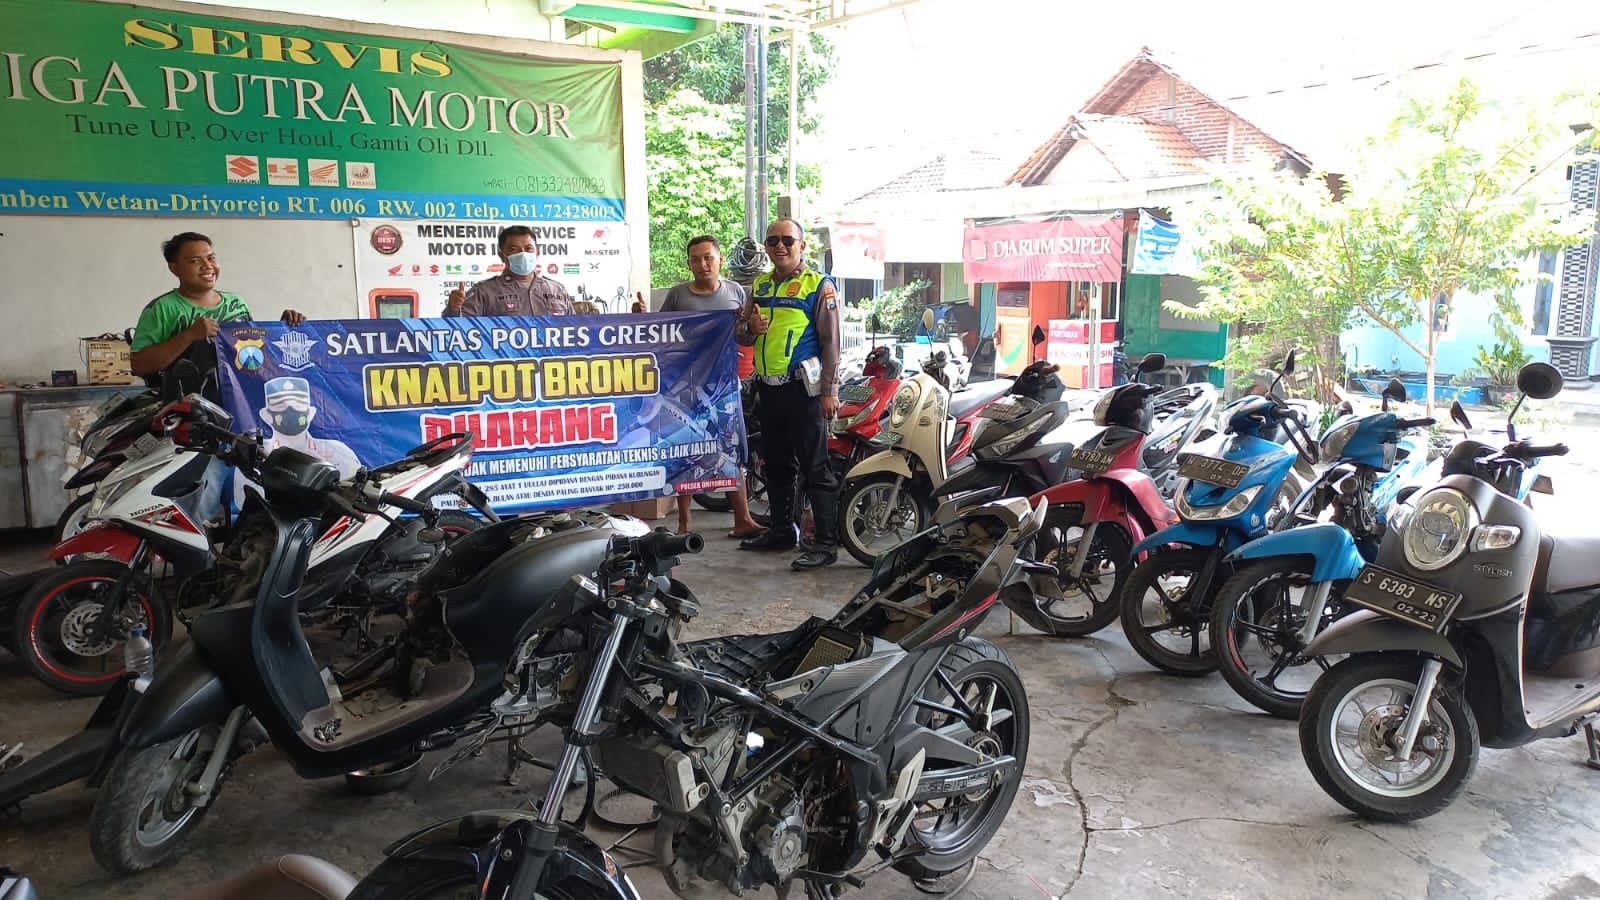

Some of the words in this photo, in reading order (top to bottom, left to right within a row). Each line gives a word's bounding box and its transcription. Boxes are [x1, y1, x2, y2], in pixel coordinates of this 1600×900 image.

[124, 19, 452, 78] SERVIS
[160, 66, 376, 125] PUTRA
[386, 87, 575, 139] MOTOR
[66, 113, 139, 137] Tune
[150, 119, 196, 142] UP,
[206, 123, 269, 145] Over
[278, 127, 342, 150] Houl,
[350, 132, 409, 152] Ganti
[417, 135, 449, 154] Oli
[458, 139, 494, 157] Dll.
[75, 191, 280, 216] Wetan-Driyorejo
[287, 196, 324, 214] RT.
[330, 199, 366, 214] 006
[378, 201, 419, 217] RW.
[424, 203, 457, 218] 002
[464, 202, 504, 220] Telp.
[531, 226, 576, 239] RVICE
[993, 239, 1055, 257] DJARUM
[1058, 236, 1112, 255] SUPER
[428, 243, 487, 256] MOTOR
[326, 328, 481, 356] SATLANTAS
[491, 325, 590, 350] POLRES
[599, 323, 685, 347] GRESIK
[368, 363, 540, 408] KNALPOT
[543, 356, 657, 397] BRONG
[489, 456, 547, 475] MEMENUHI
[550, 450, 621, 469] PERSYARATAN
[622, 447, 658, 463] TEKNIS
[660, 448, 668, 460] &
[669, 444, 689, 459] LAIK
[690, 440, 718, 456] JALAN
[501, 482, 516, 491] AYAT
[556, 487, 579, 496] PALING
[128, 503, 165, 517] HONDA
[1472, 563, 1514, 578] STYLISH
[1363, 572, 1376, 584] S
[1378, 578, 1416, 600] 6383
[1424, 592, 1448, 609] NS
